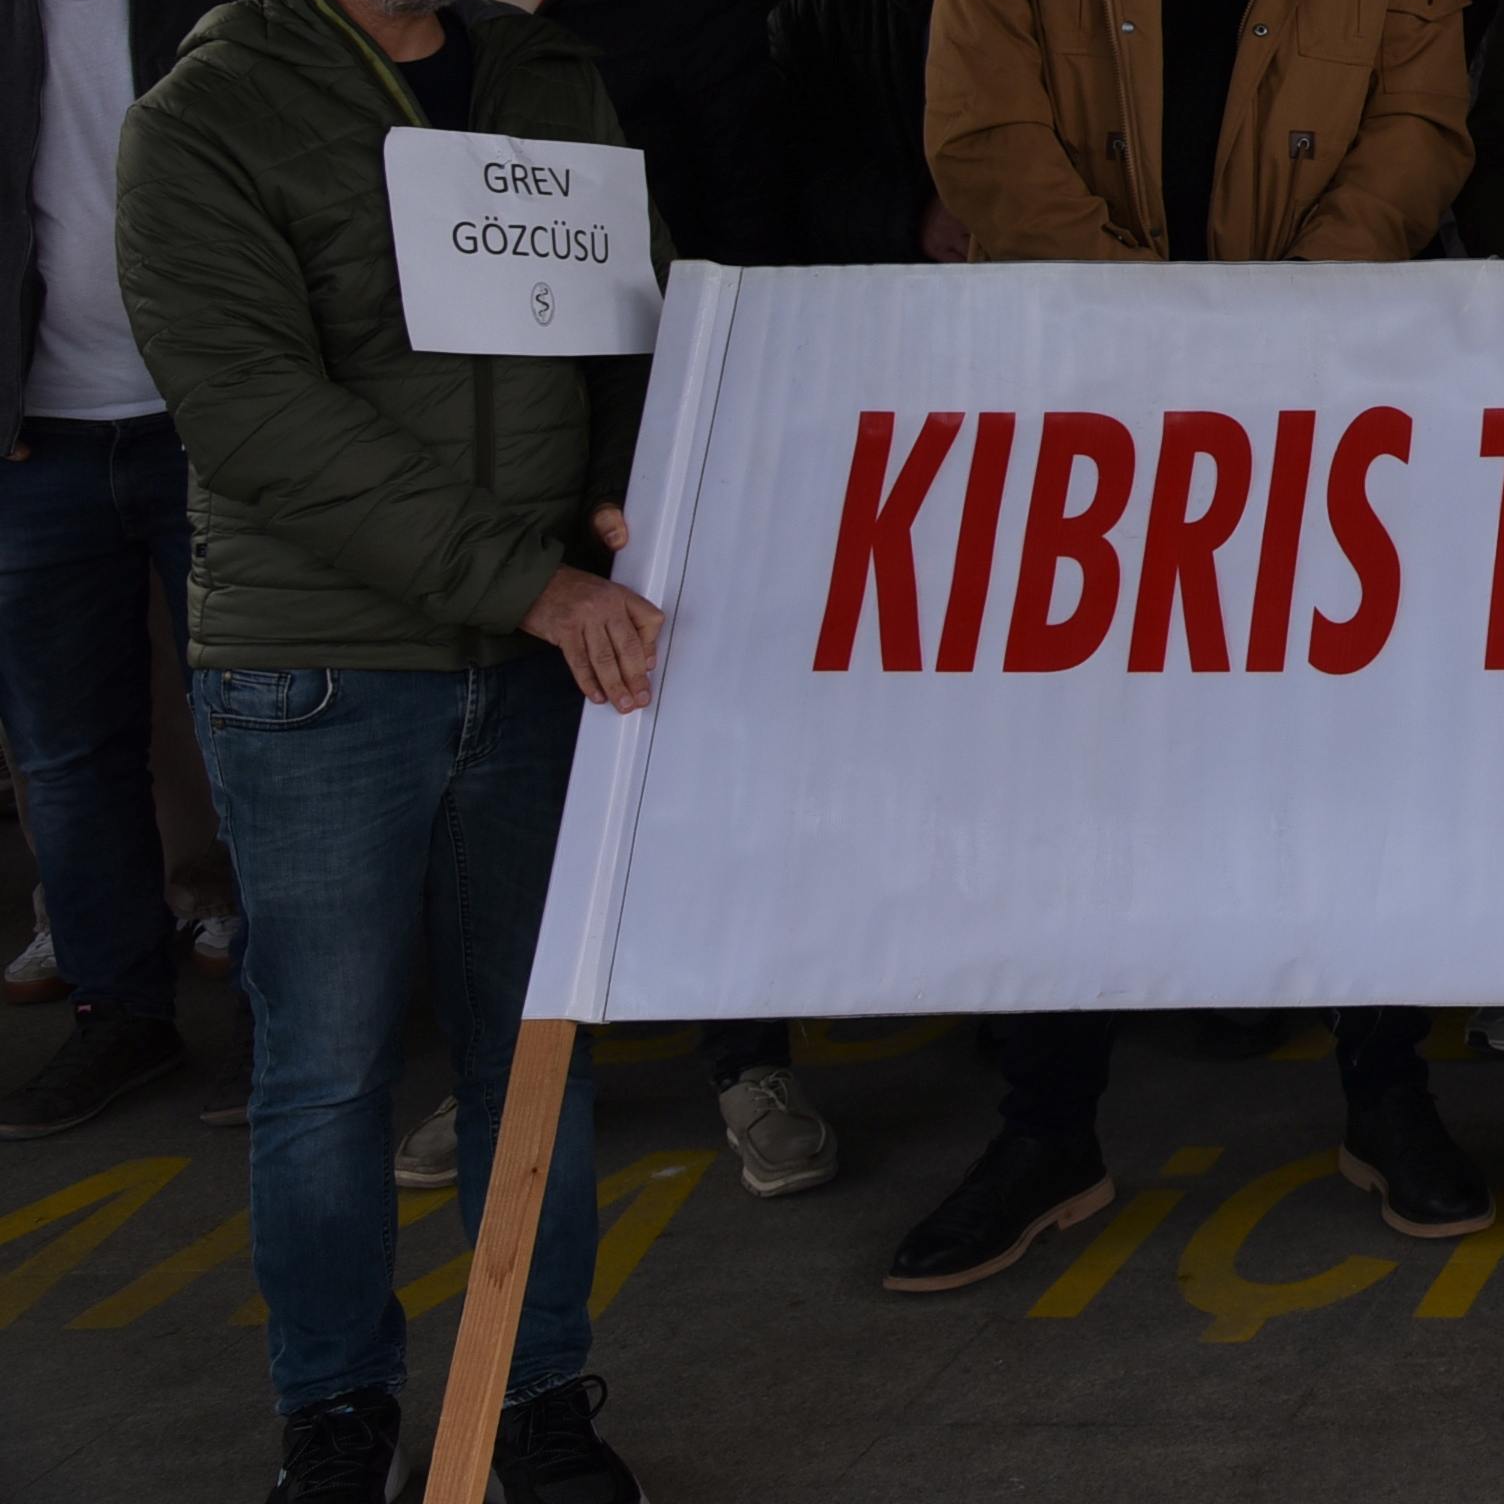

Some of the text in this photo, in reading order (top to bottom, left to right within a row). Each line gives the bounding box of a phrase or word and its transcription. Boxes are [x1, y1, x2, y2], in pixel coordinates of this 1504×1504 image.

[483, 161, 571, 198] GREV
[452, 215, 609, 264] GÖZCÜSÜ
[813, 406, 1414, 676] KIBRIS
